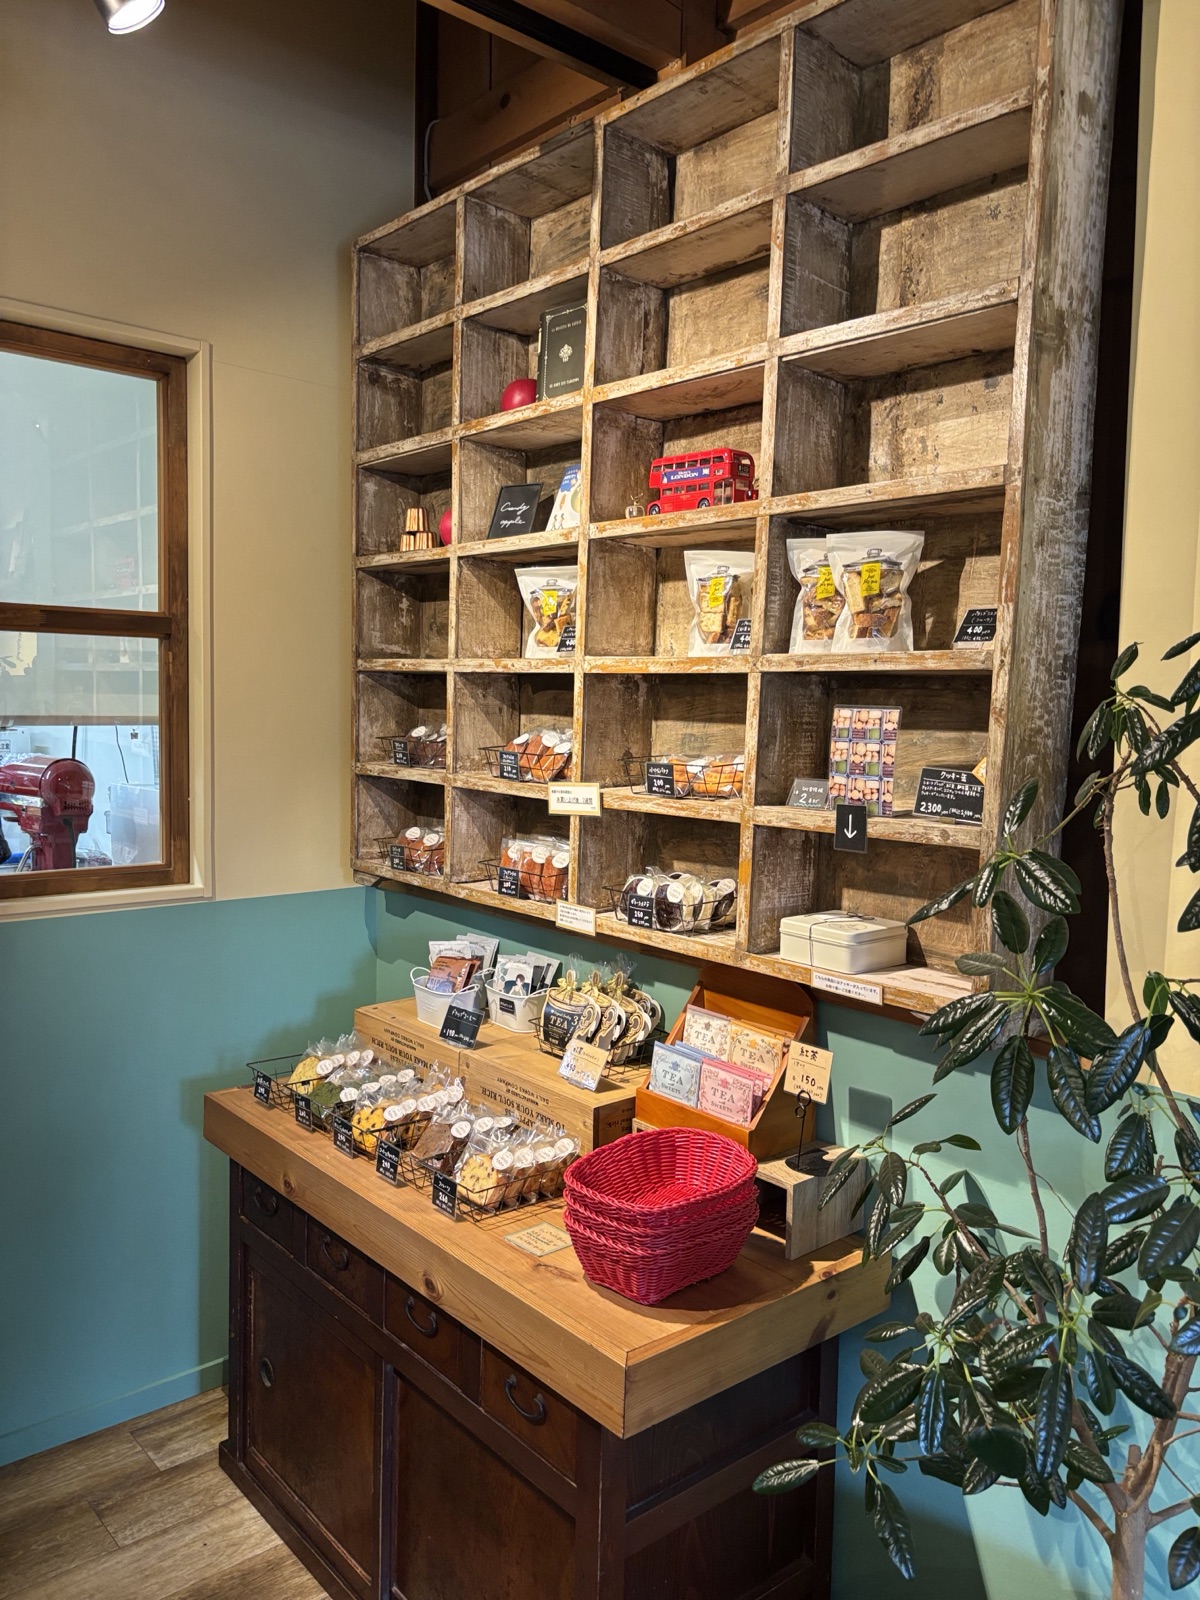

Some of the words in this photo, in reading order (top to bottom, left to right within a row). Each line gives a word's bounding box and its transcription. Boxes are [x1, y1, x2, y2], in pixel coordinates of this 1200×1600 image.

[670, 472, 698, 480] LONDON
[500, 502, 530, 516] Candy
[500, 516, 526, 528] apple
[940, 771, 967, 782] クッキー缶
[920, 802, 942, 813] 2,300
[550, 1015, 568, 1030] TEA
[571, 1016, 579, 1026] 3
[384, 1028, 400, 1038] COMPANY
[694, 1030, 716, 1044] TEA
[401, 1035, 412, 1044] WORKS
[414, 1040, 424, 1049] DAILY
[385, 1043, 397, 1054] SOUL
[799, 1046, 818, 1062] 紅茶
[398, 1049, 412, 1061] YOUR
[740, 1047, 765, 1064] TEA
[497, 1077, 518, 1090] COMPANY
[662, 1069, 684, 1086] TEA
[801, 1074, 816, 1086] 150
[519, 1086, 534, 1097] WORKS
[661, 1082, 681, 1094] SWEETS
[498, 1094, 514, 1108] SOUL
[511, 1090, 539, 1106] MANUFACTURED
[536, 1094, 549, 1105] DAILY
[711, 1087, 735, 1104] TEA
[516, 1103, 534, 1118] YOUR
[710, 1101, 733, 1113] SWEETS
